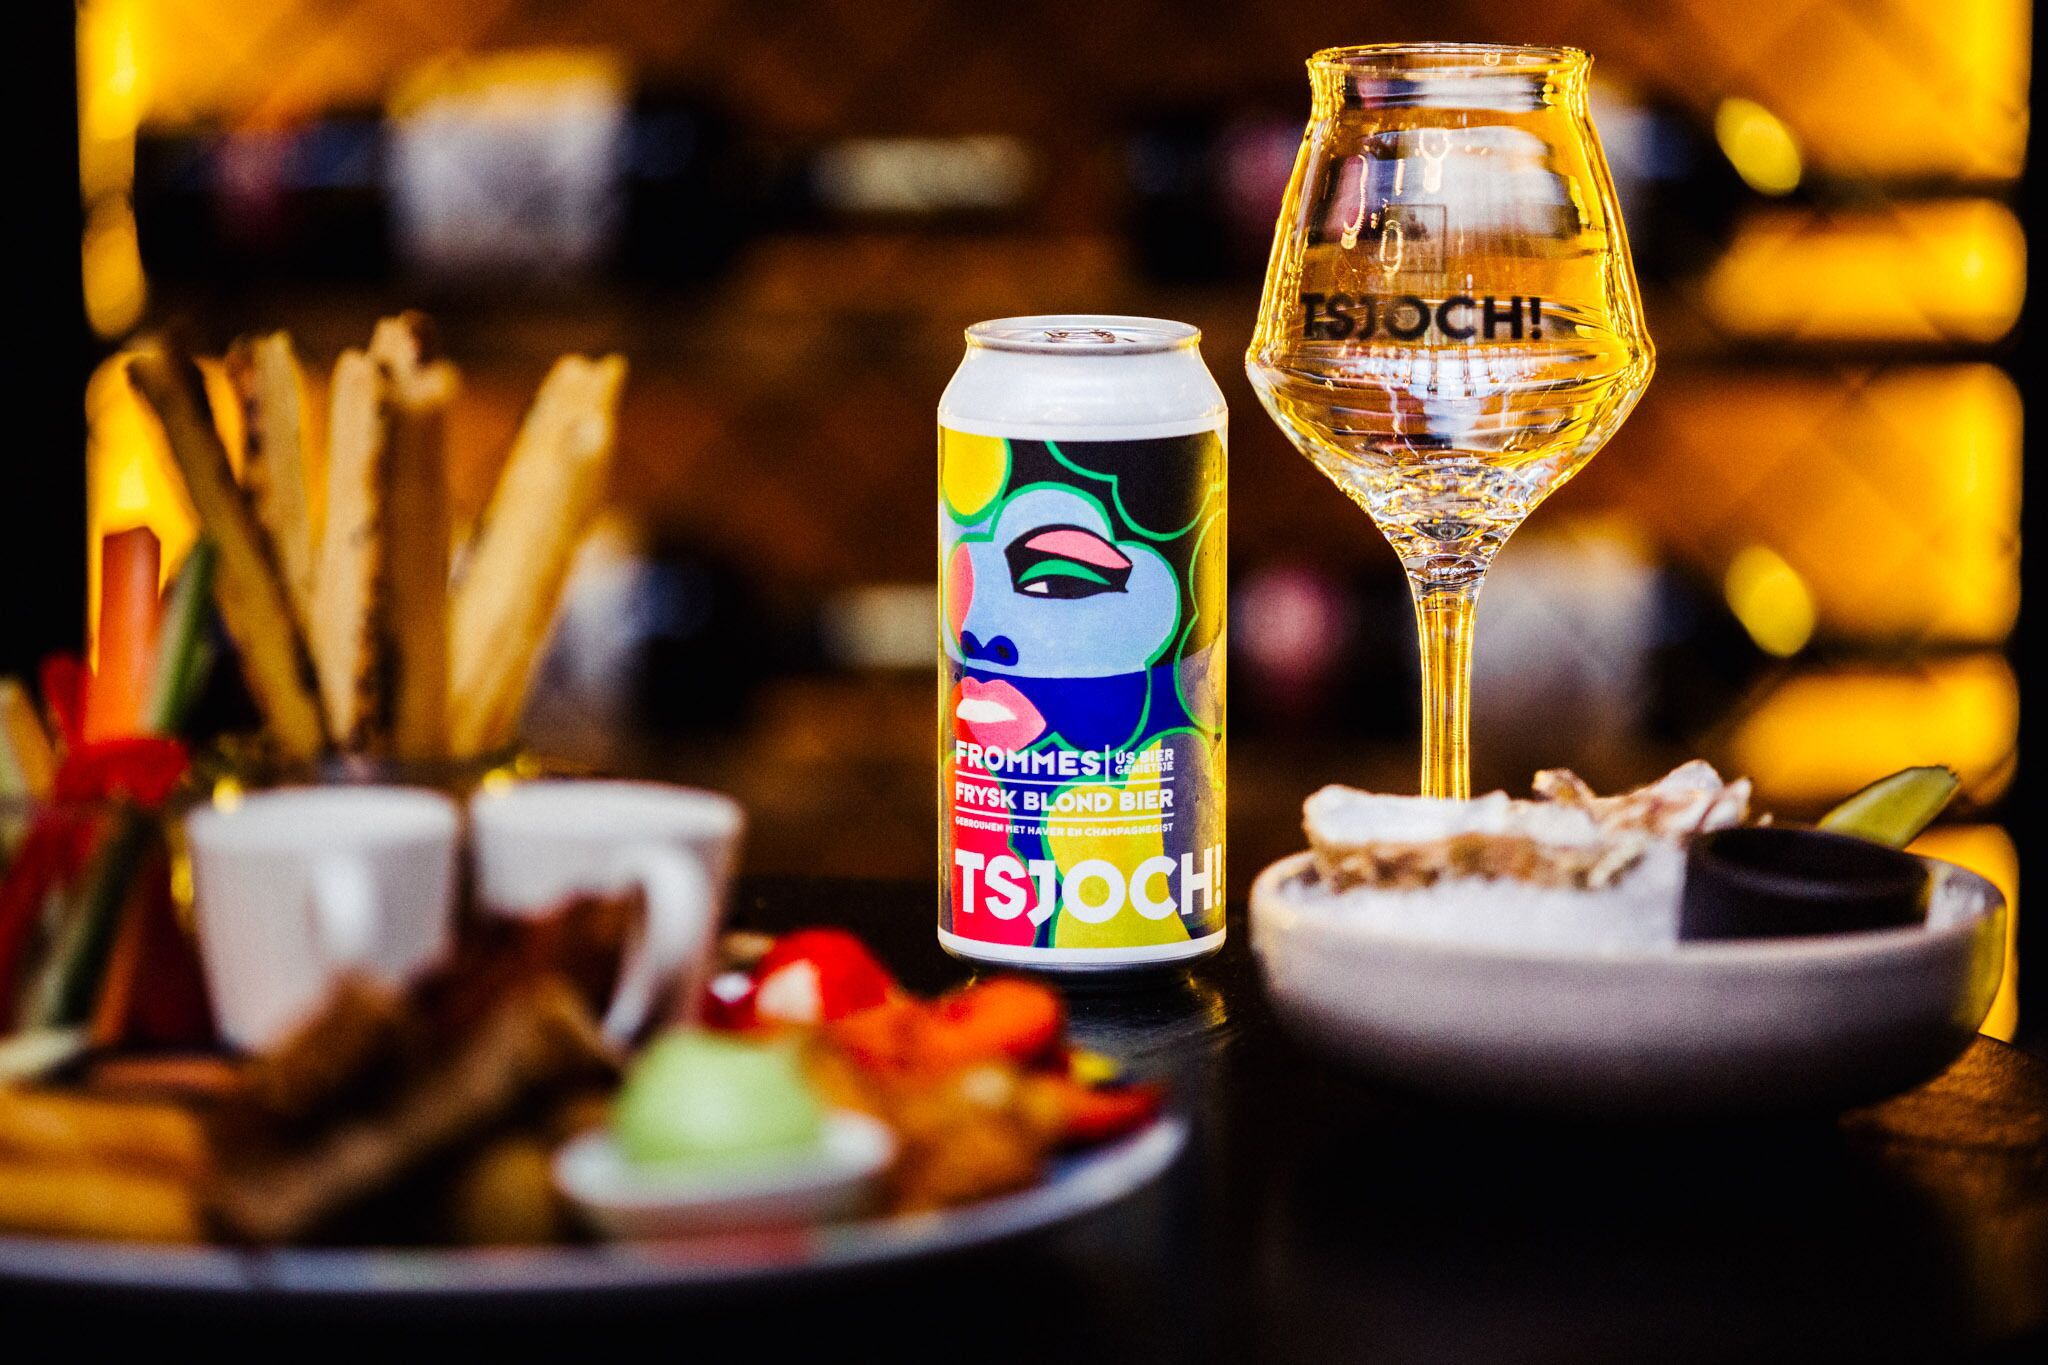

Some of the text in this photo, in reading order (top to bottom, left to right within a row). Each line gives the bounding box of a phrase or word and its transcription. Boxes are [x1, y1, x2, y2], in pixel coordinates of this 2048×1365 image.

[1300, 293, 1542, 341] TSJOCH!
[955, 739, 1100, 777] FROMMES
[1140, 748, 1174, 763] BIER
[955, 781, 1174, 813] FRYSK BLOND BIER
[955, 815, 1174, 837] GEBROUWEN MET HAVER EN CHAMPAGNEGIST
[955, 844, 1223, 928] TSJOCH!
